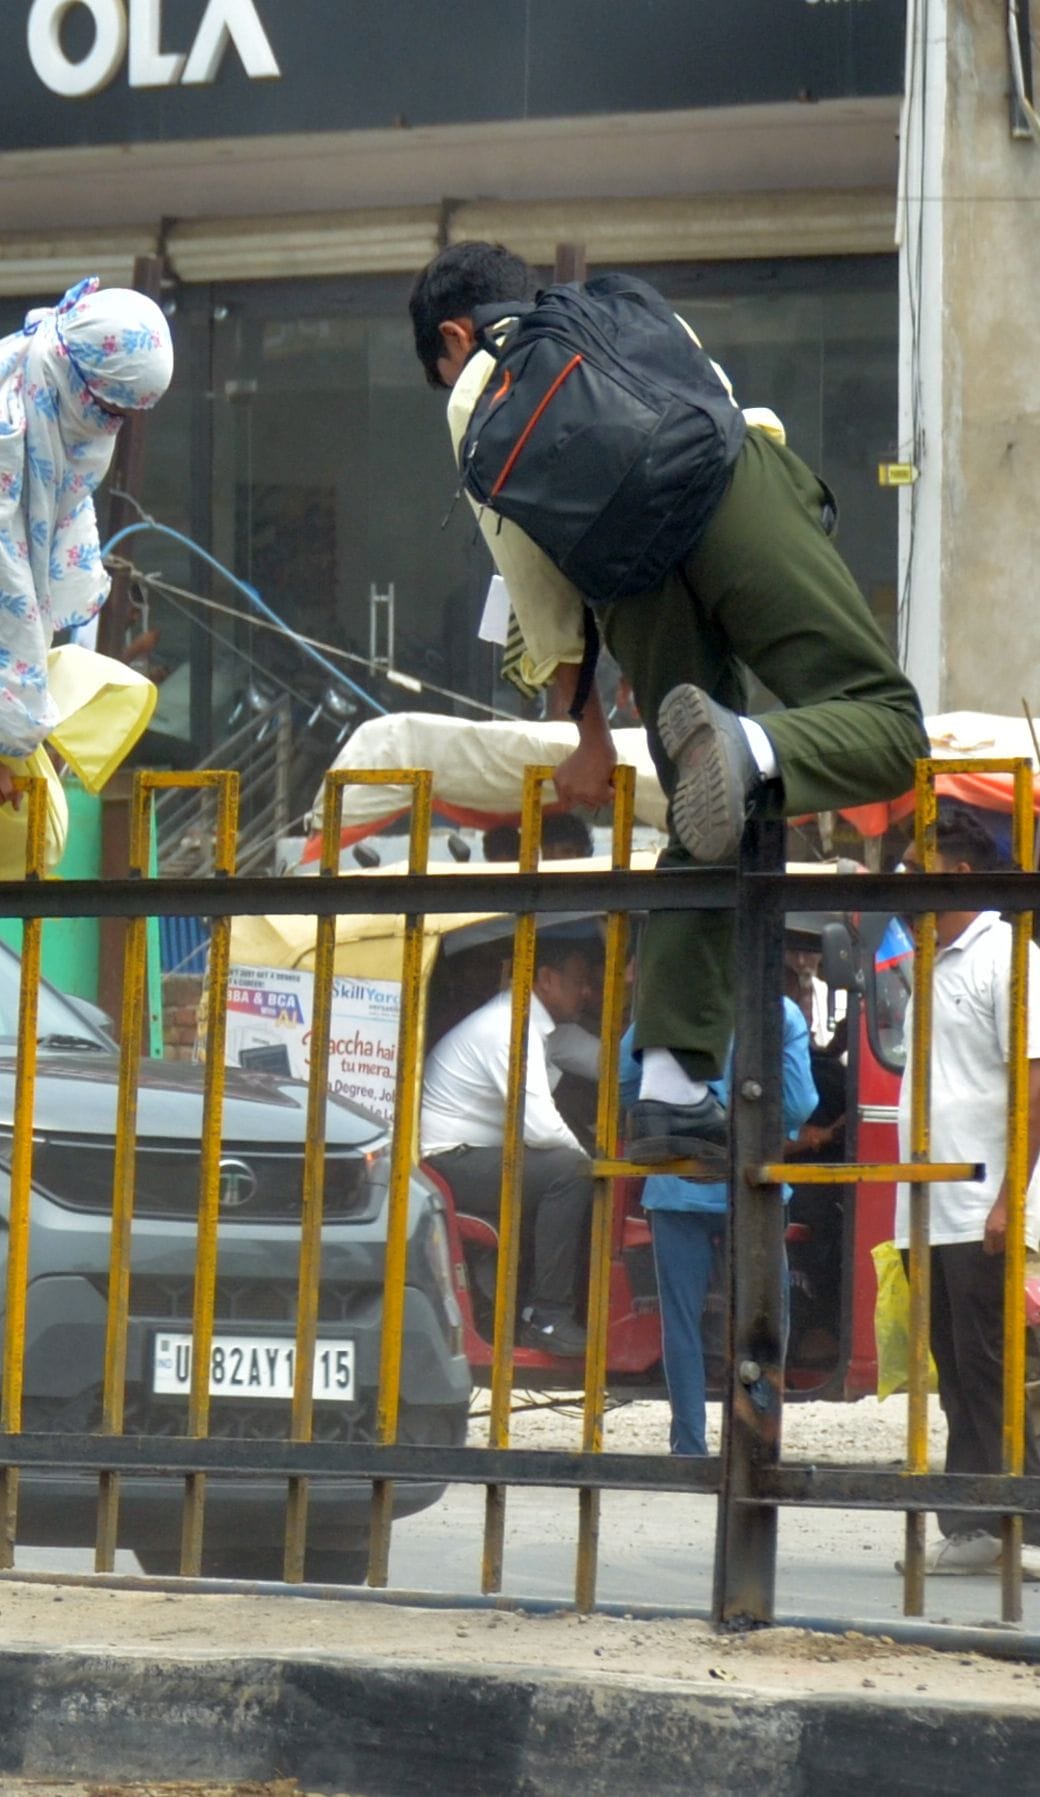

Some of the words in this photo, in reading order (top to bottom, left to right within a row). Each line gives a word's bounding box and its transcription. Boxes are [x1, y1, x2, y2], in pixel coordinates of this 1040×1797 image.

[27, 0, 281, 97] OLA
[253, 992, 263, 1005] &
[268, 993, 296, 1008] BCA
[376, 1040, 396, 1061] hai
[341, 1059, 355, 1073] tu
[176, 1345, 350, 1389] U82AY115
